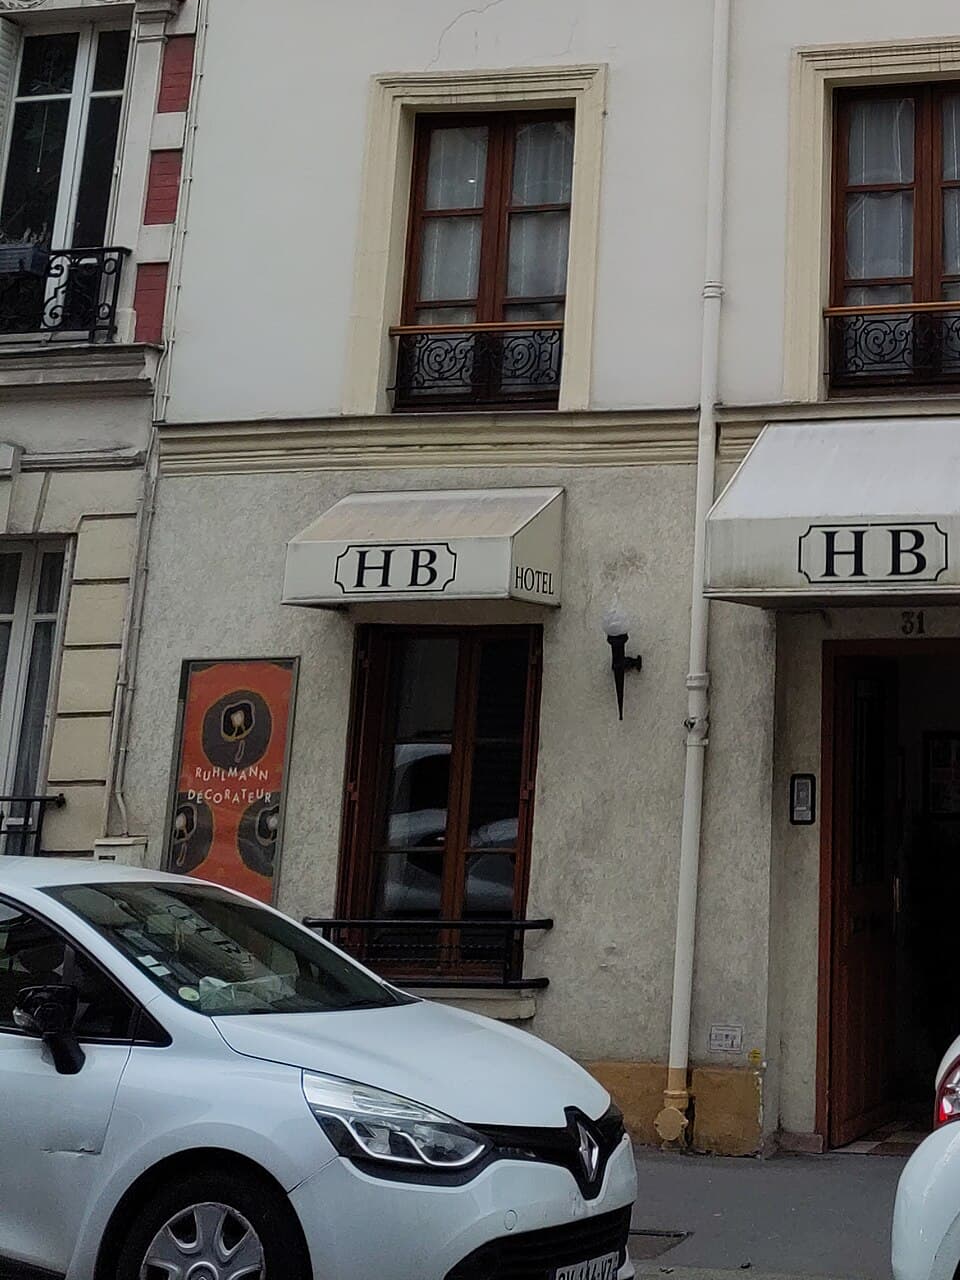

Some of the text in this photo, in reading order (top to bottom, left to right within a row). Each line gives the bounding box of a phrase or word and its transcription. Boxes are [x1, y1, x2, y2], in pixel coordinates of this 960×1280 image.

[515, 566, 554, 595] HOTEL
[901, 610, 926, 635] 31
[195, 766, 269, 781] RUHLMANN
